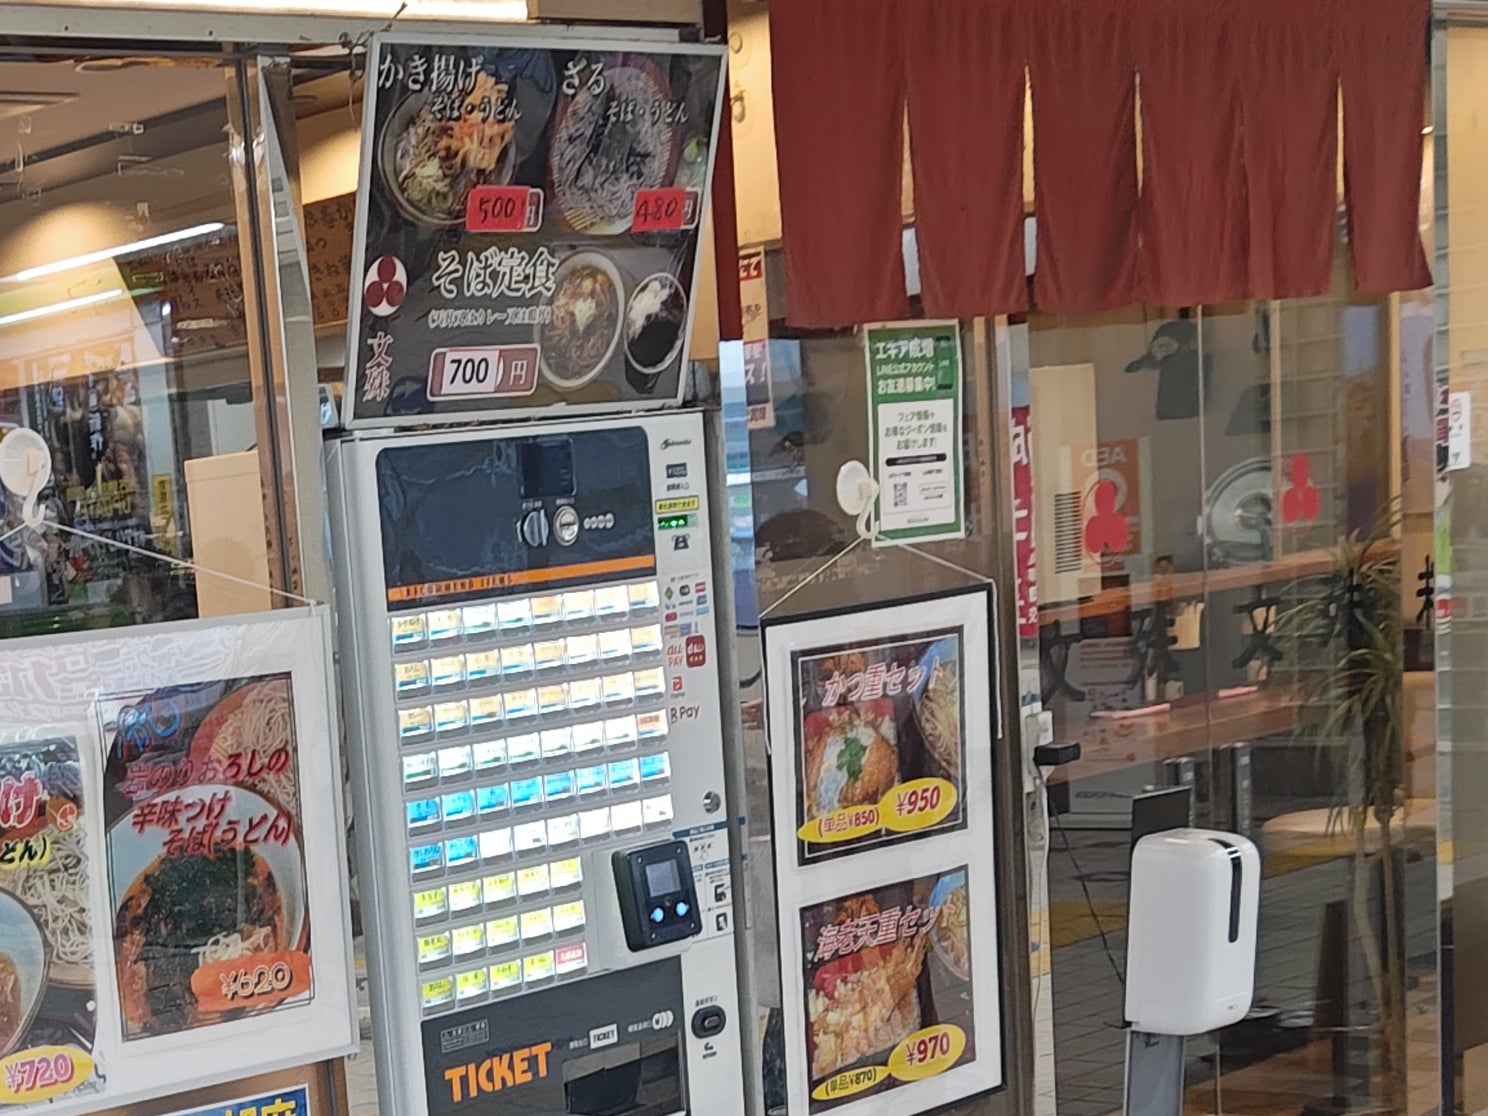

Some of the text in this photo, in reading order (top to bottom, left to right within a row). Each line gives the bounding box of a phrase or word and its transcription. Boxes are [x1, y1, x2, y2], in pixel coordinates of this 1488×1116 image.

[378, 54, 482, 93] かき揚げ
[478, 198, 515, 219] 500
[432, 246, 559, 299] そば定食
[449, 357, 490, 385] 700
[822, 655, 944, 707] かつ重セット
[132, 791, 231, 833] 辛味つけ
[896, 784, 942, 818] ¥950
[220, 962, 293, 999] ¥620
[906, 1030, 951, 1066] ¥970
[5, 1054, 73, 1089] ¥720
[444, 1041, 553, 1102] TICKET
